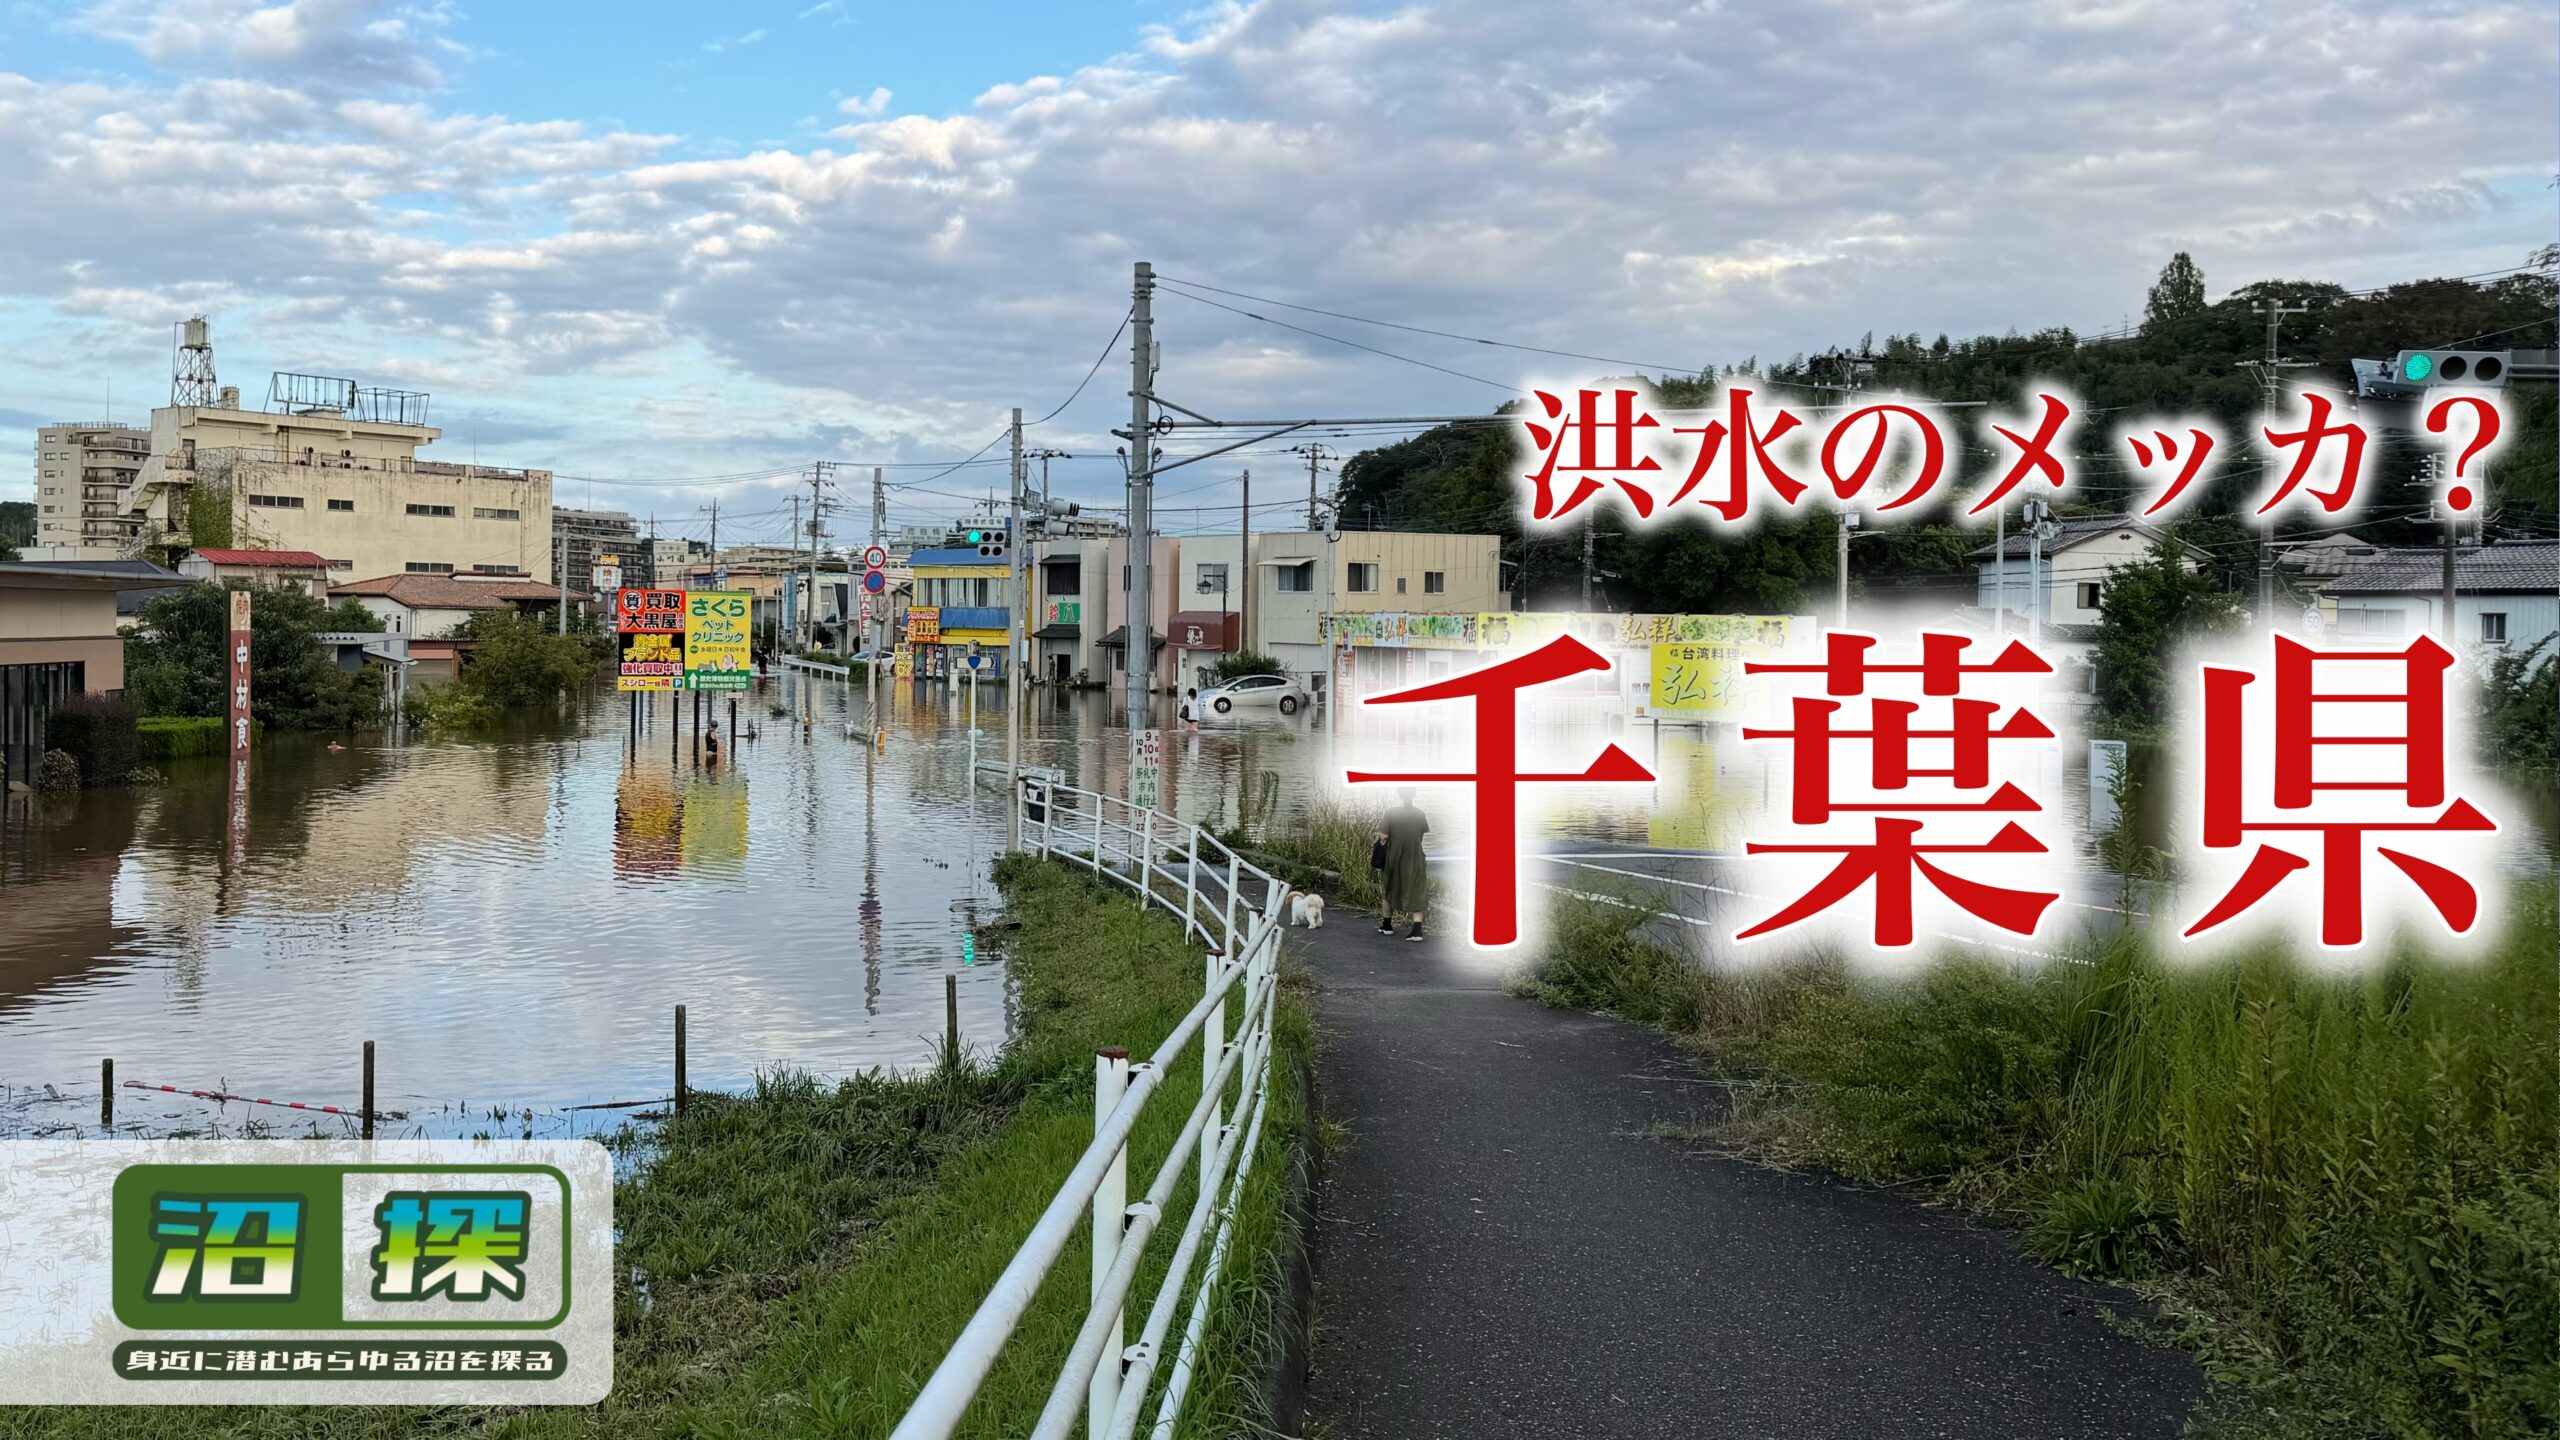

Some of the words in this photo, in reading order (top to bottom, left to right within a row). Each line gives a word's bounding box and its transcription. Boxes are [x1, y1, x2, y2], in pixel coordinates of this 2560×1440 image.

[869, 553, 881, 563] 40
[645, 592, 681, 610] 買取
[691, 598, 746, 617] さくら
[626, 612, 678, 629] 大黒屋
[702, 620, 734, 631] ペット
[691, 632, 744, 643] クリニック
[1463, 616, 1477, 646] 福
[1482, 616, 1511, 647] 福
[1620, 616, 1676, 643] 弘祥
[1757, 620, 1785, 649] 福
[623, 648, 682, 662] ブランド品
[1681, 646, 1740, 661] 台湾料理
